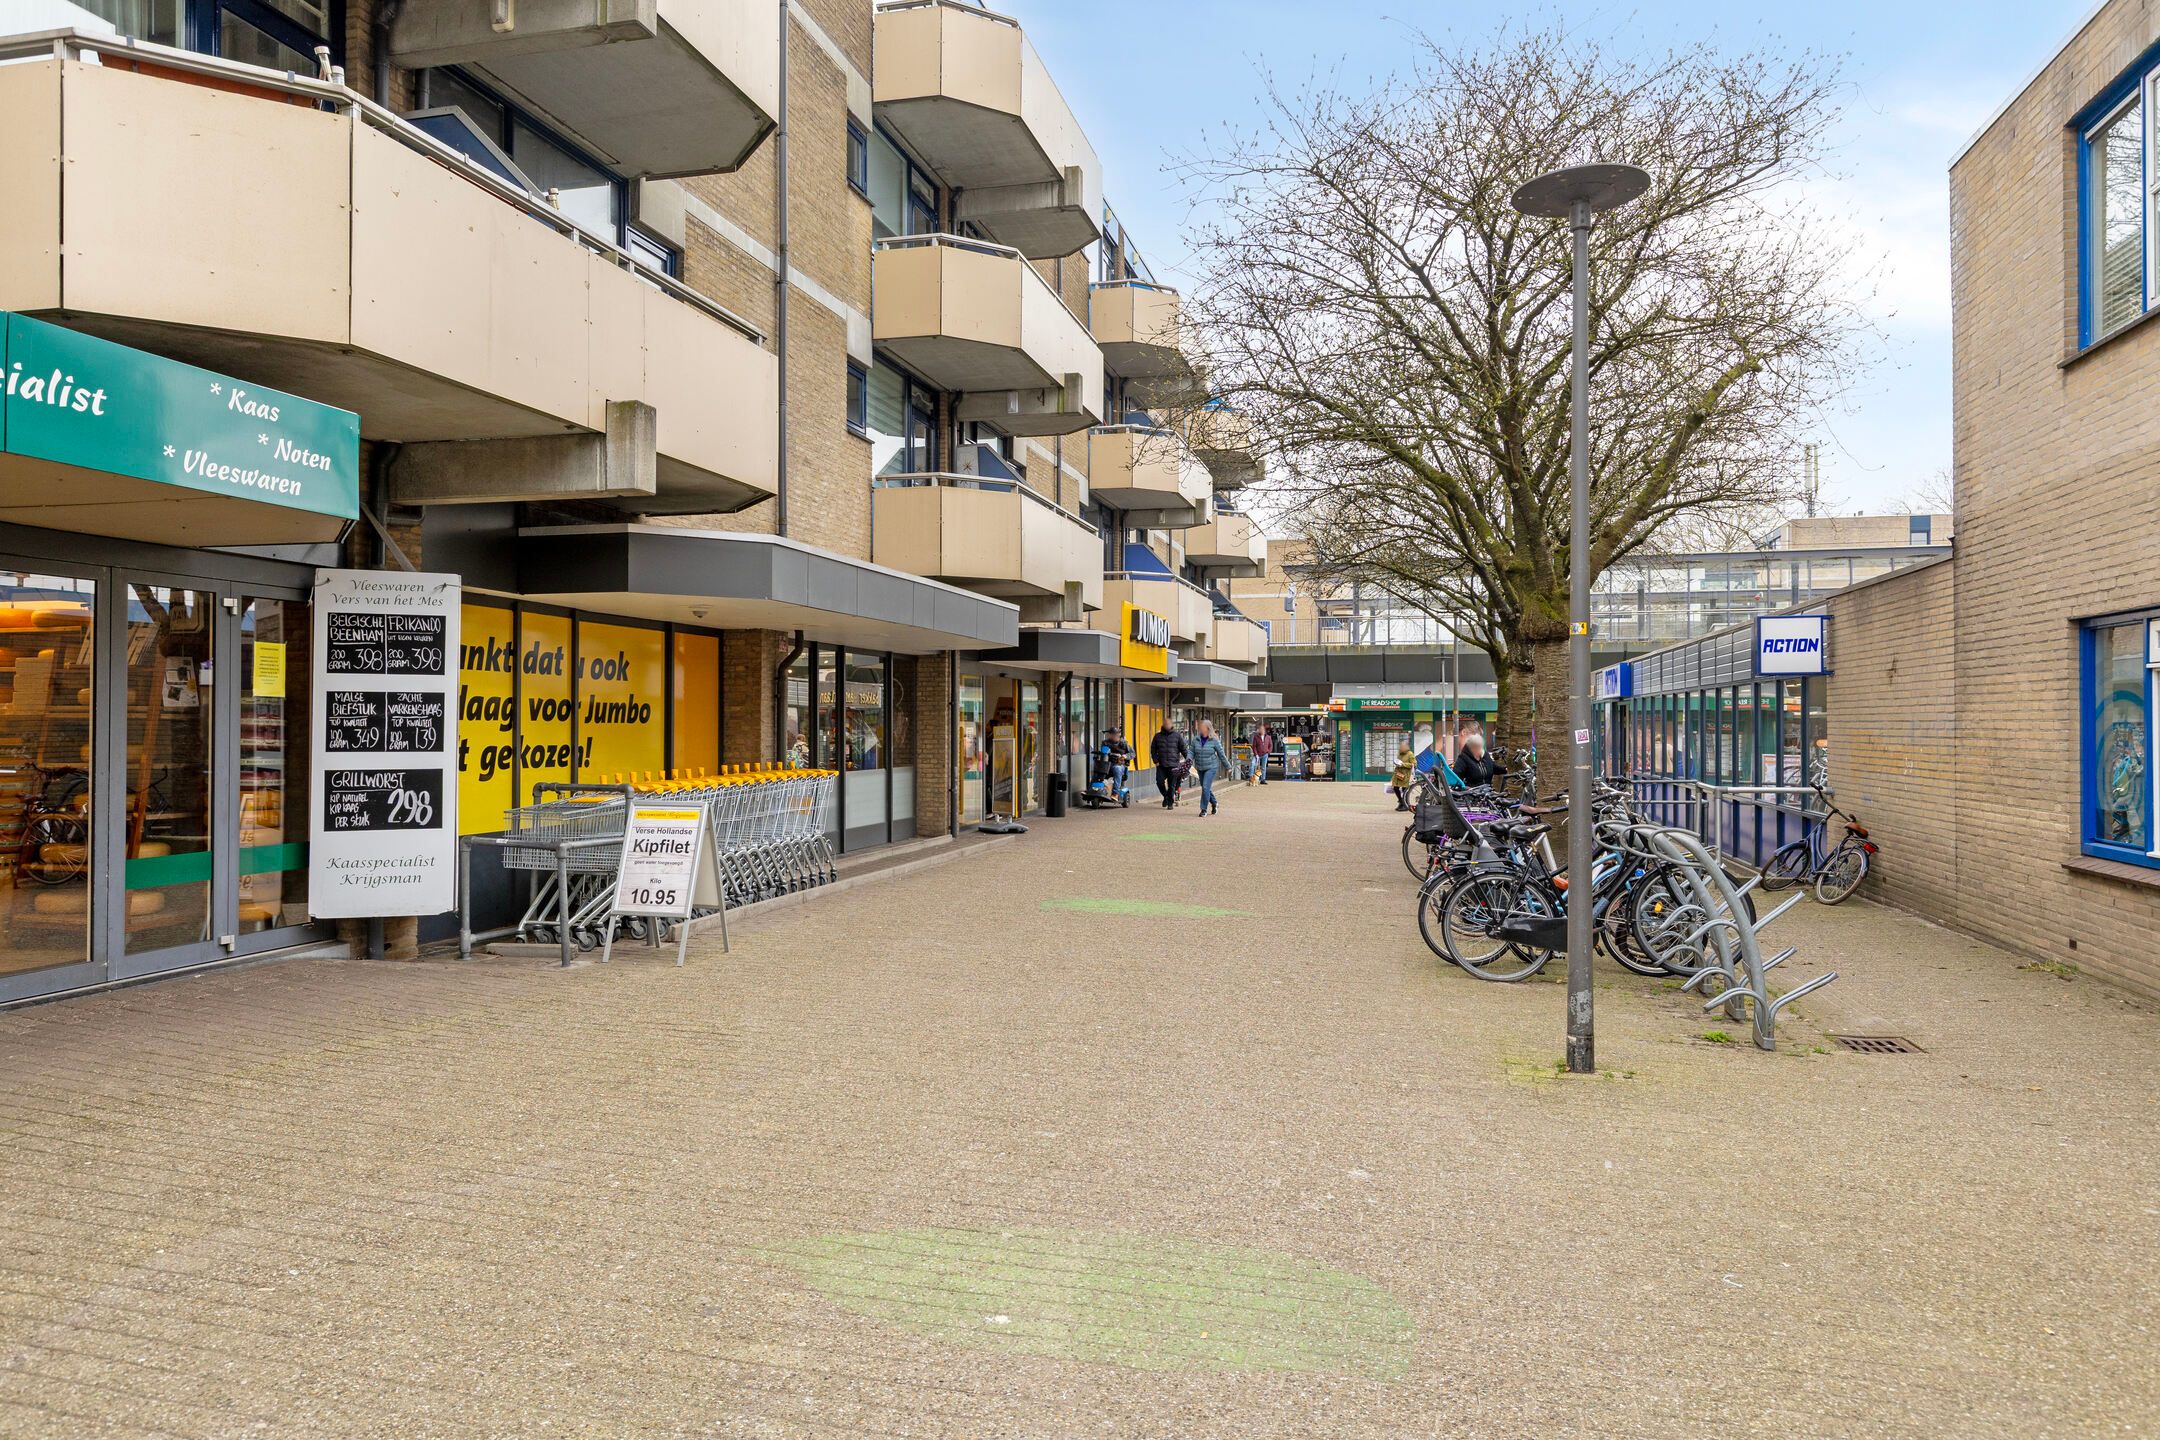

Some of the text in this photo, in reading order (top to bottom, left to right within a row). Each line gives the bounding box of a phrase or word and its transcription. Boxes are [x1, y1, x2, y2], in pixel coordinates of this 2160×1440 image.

[228, 388, 280, 422] Kaas
[274, 438, 331, 471] Noten
[183, 450, 301, 496] Vleeswaren
[351, 579, 425, 592] Vleeswaren
[332, 593, 443, 607] Vers van het Mes
[329, 613, 385, 628] BELGISCHE
[388, 615, 441, 633] FRIKANDO
[330, 628, 384, 643] BEENHAM
[1137, 609, 1171, 649] JUMBO
[1762, 638, 1820, 653] ACTION
[331, 649, 346, 660] 200
[388, 649, 404, 659] 200
[523, 641, 564, 676] dat
[590, 651, 630, 681] ook
[328, 660, 351, 670] GRAM
[387, 659, 410, 668] GRAM
[334, 692, 365, 702] MALSE
[332, 703, 377, 716] BIEFSTUK
[584, 694, 651, 724] Jumbo
[329, 739, 350, 750] GRAM
[331, 771, 406, 788] GRILLWORST
[330, 793, 341, 803] KIP
[329, 803, 342, 815] KIP
[633, 839, 690, 857] Kipfilet
[326, 855, 435, 872] Kaasspecialist
[339, 873, 422, 888] Krijgsman
[631, 888, 676, 905] 10.95
